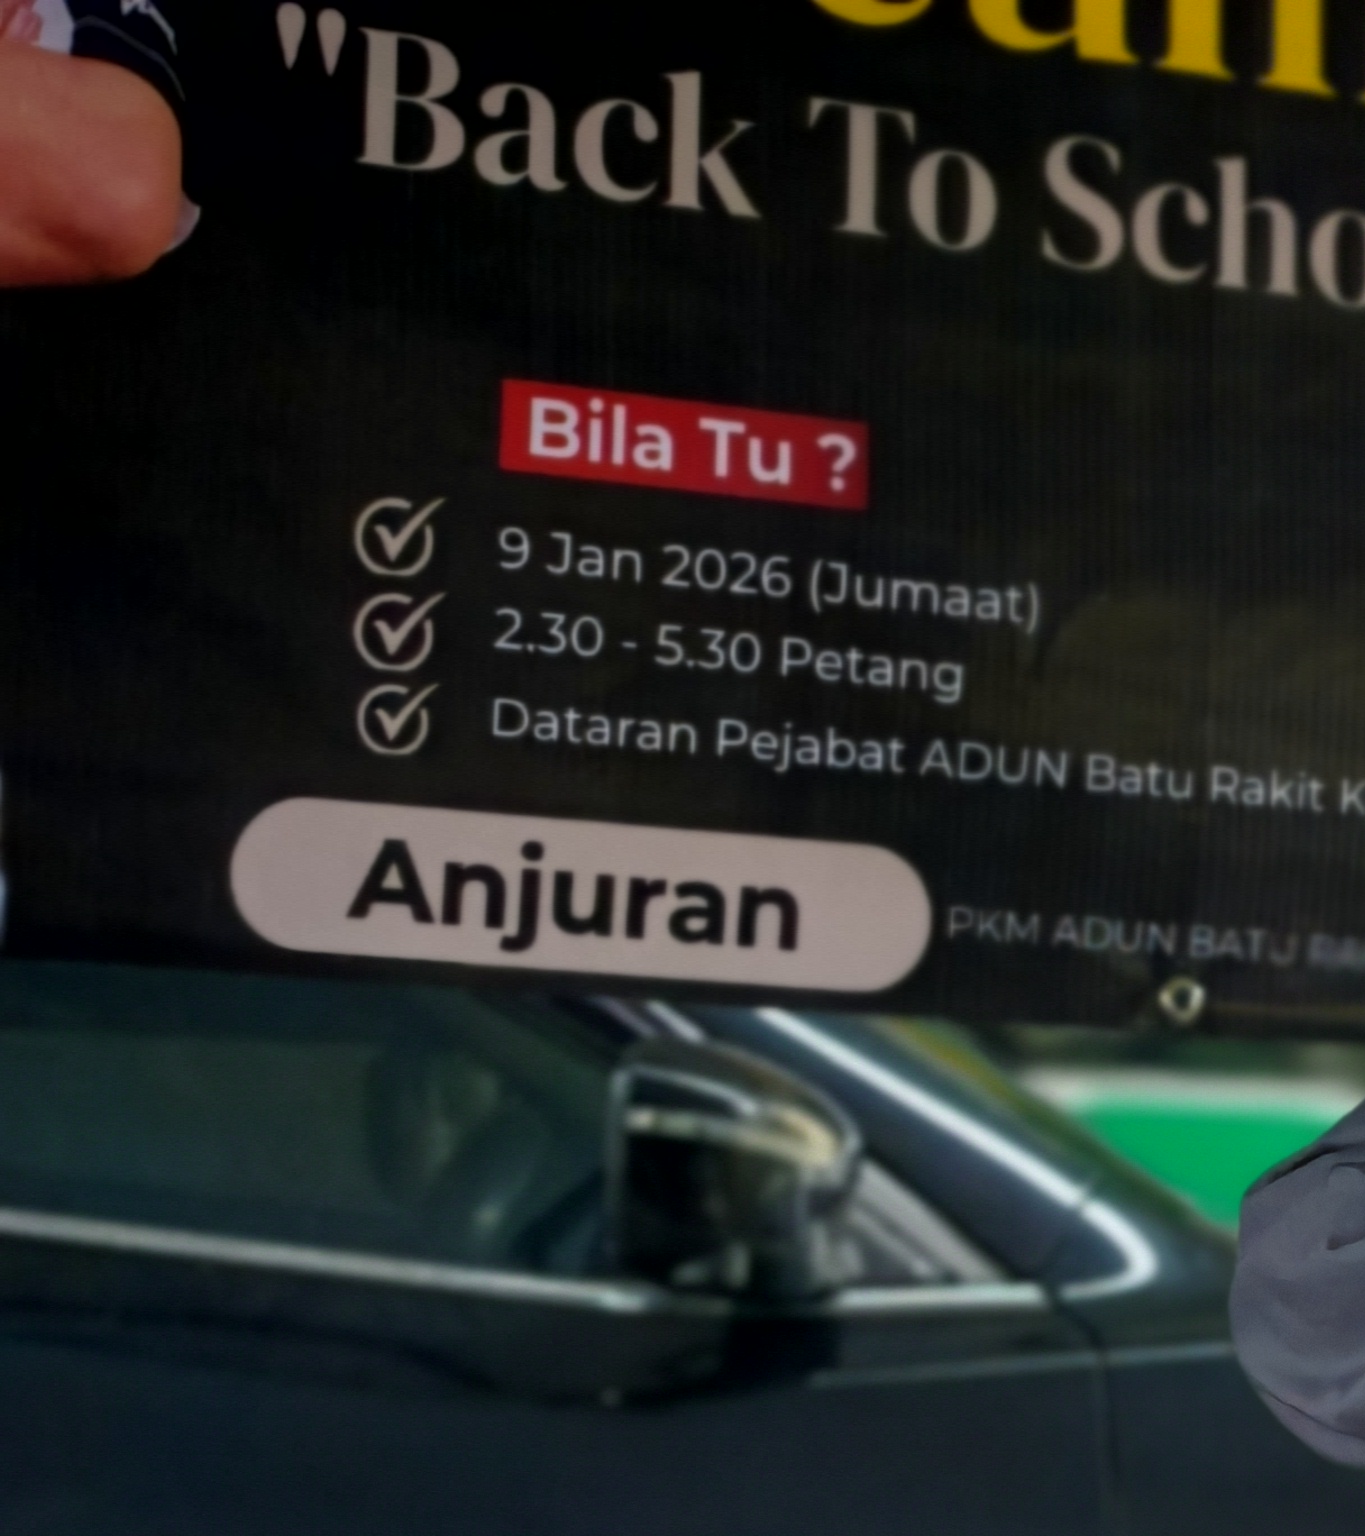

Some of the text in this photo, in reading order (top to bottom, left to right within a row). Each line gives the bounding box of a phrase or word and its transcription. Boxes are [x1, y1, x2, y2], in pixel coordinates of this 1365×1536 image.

[276, 2, 760, 219] "Back
[809, 97, 998, 251] To
[528, 397, 857, 492] Bila Tu ?
[498, 526, 1041, 636] 9 Jan 2026 (Jumaat)
[493, 606, 605, 658] 2.30
[654, 623, 762, 674] 5.30
[779, 635, 965, 705] Petang
[491, 697, 698, 754] Dataran
[716, 717, 905, 774] Pejabat
[919, 738, 1070, 788] ADUN
[1086, 752, 1194, 800] Batu
[1210, 765, 1324, 811] Rakit
[346, 838, 799, 952] Anjuran
[947, 905, 1041, 942] PKM
[1053, 915, 1177, 956] ADUN
